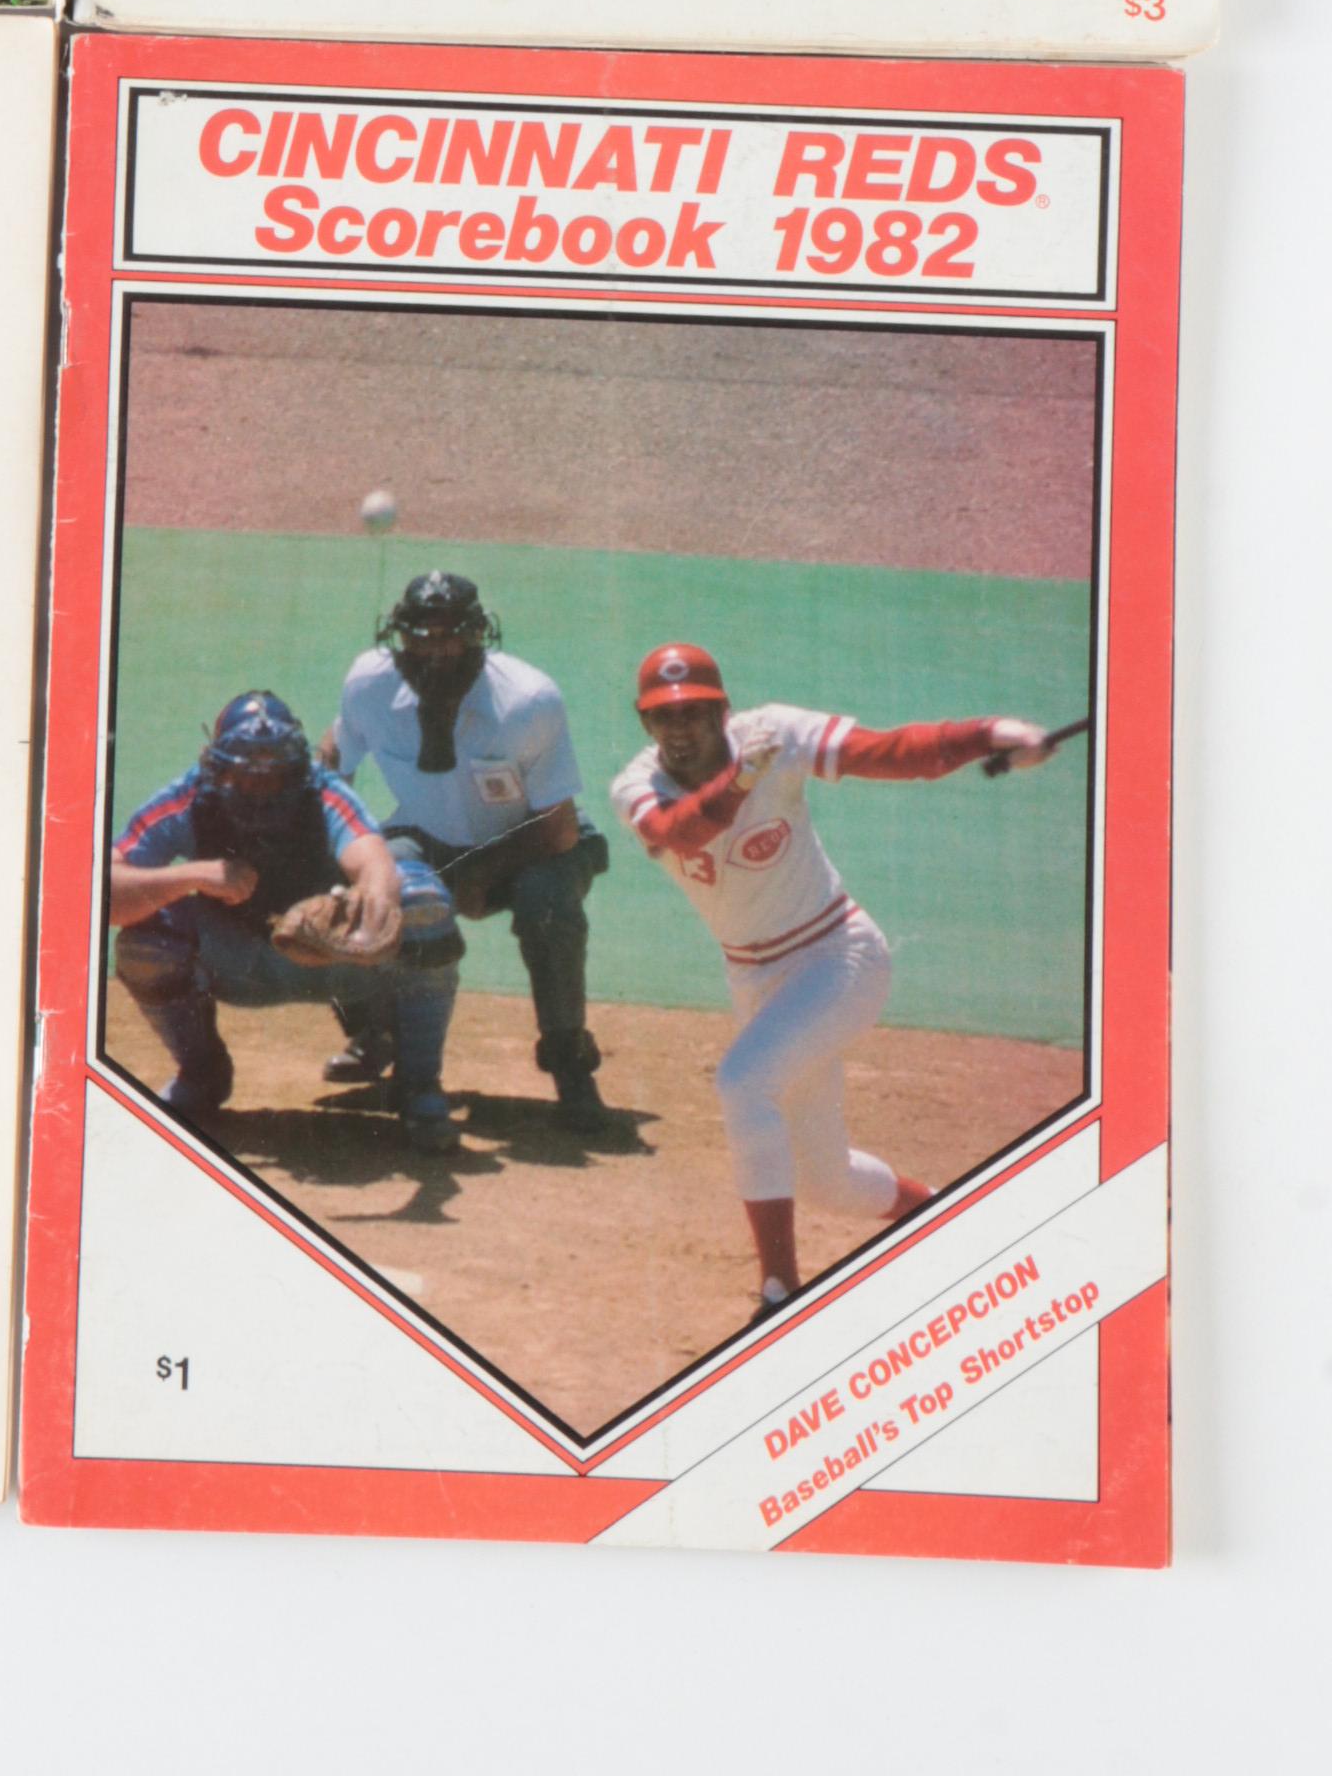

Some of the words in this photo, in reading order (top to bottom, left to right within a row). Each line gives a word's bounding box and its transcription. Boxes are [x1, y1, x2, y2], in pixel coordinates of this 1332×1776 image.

[199, 108, 733, 194] CINCINNATI
[773, 130, 1042, 208] REDS
[255, 186, 723, 270] Scorebook
[773, 208, 979, 279] 1982
[155, 1354, 189, 1391] $1
[759, 1421, 900, 1527] Baseball's
[899, 1380, 954, 1425] Top
[960, 1281, 1100, 1384] Shortstop
[764, 1389, 845, 1460] DAVE
[849, 1255, 1040, 1401] CONCEPCION
